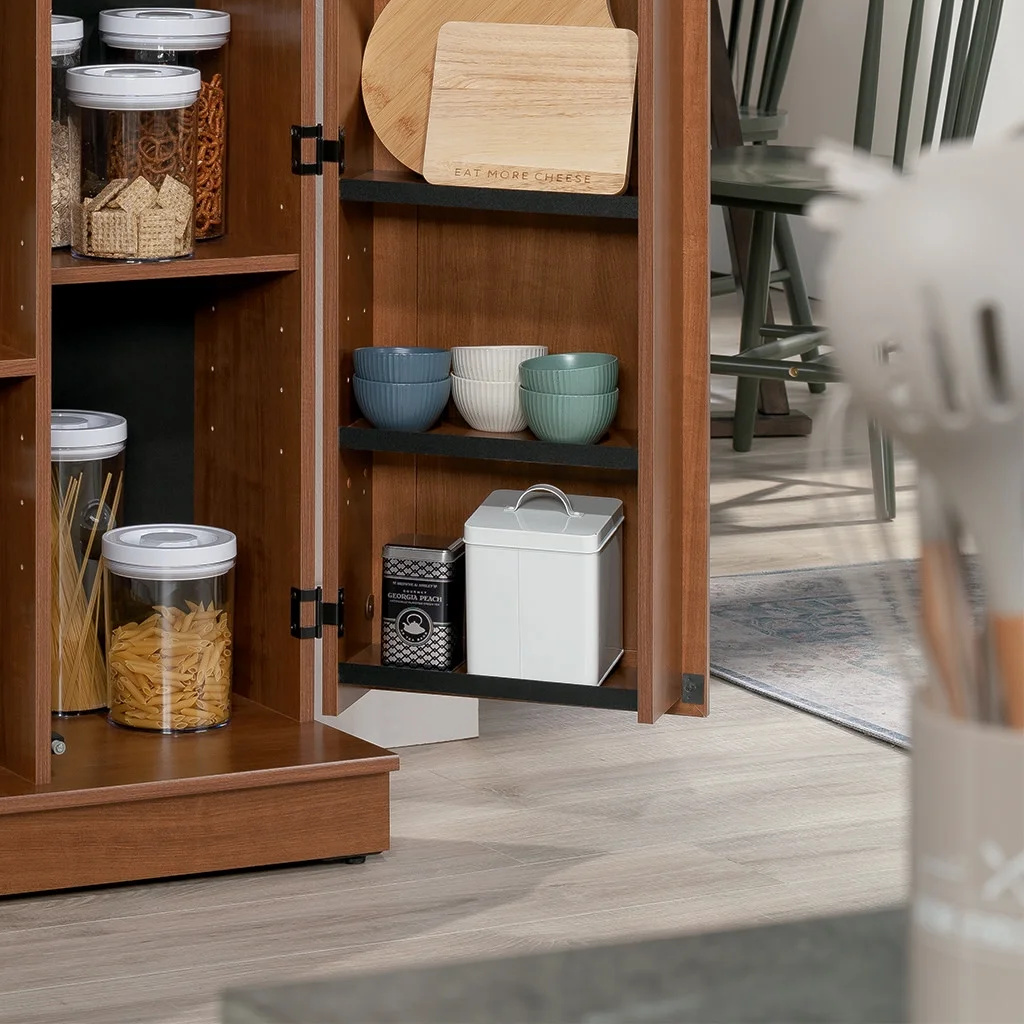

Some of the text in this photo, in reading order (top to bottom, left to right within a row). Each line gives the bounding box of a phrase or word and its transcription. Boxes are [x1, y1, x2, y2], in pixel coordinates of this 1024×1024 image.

[454, 168, 591, 184] EAT MORE CHEESE
[388, 592, 418, 600] GEORGIA
